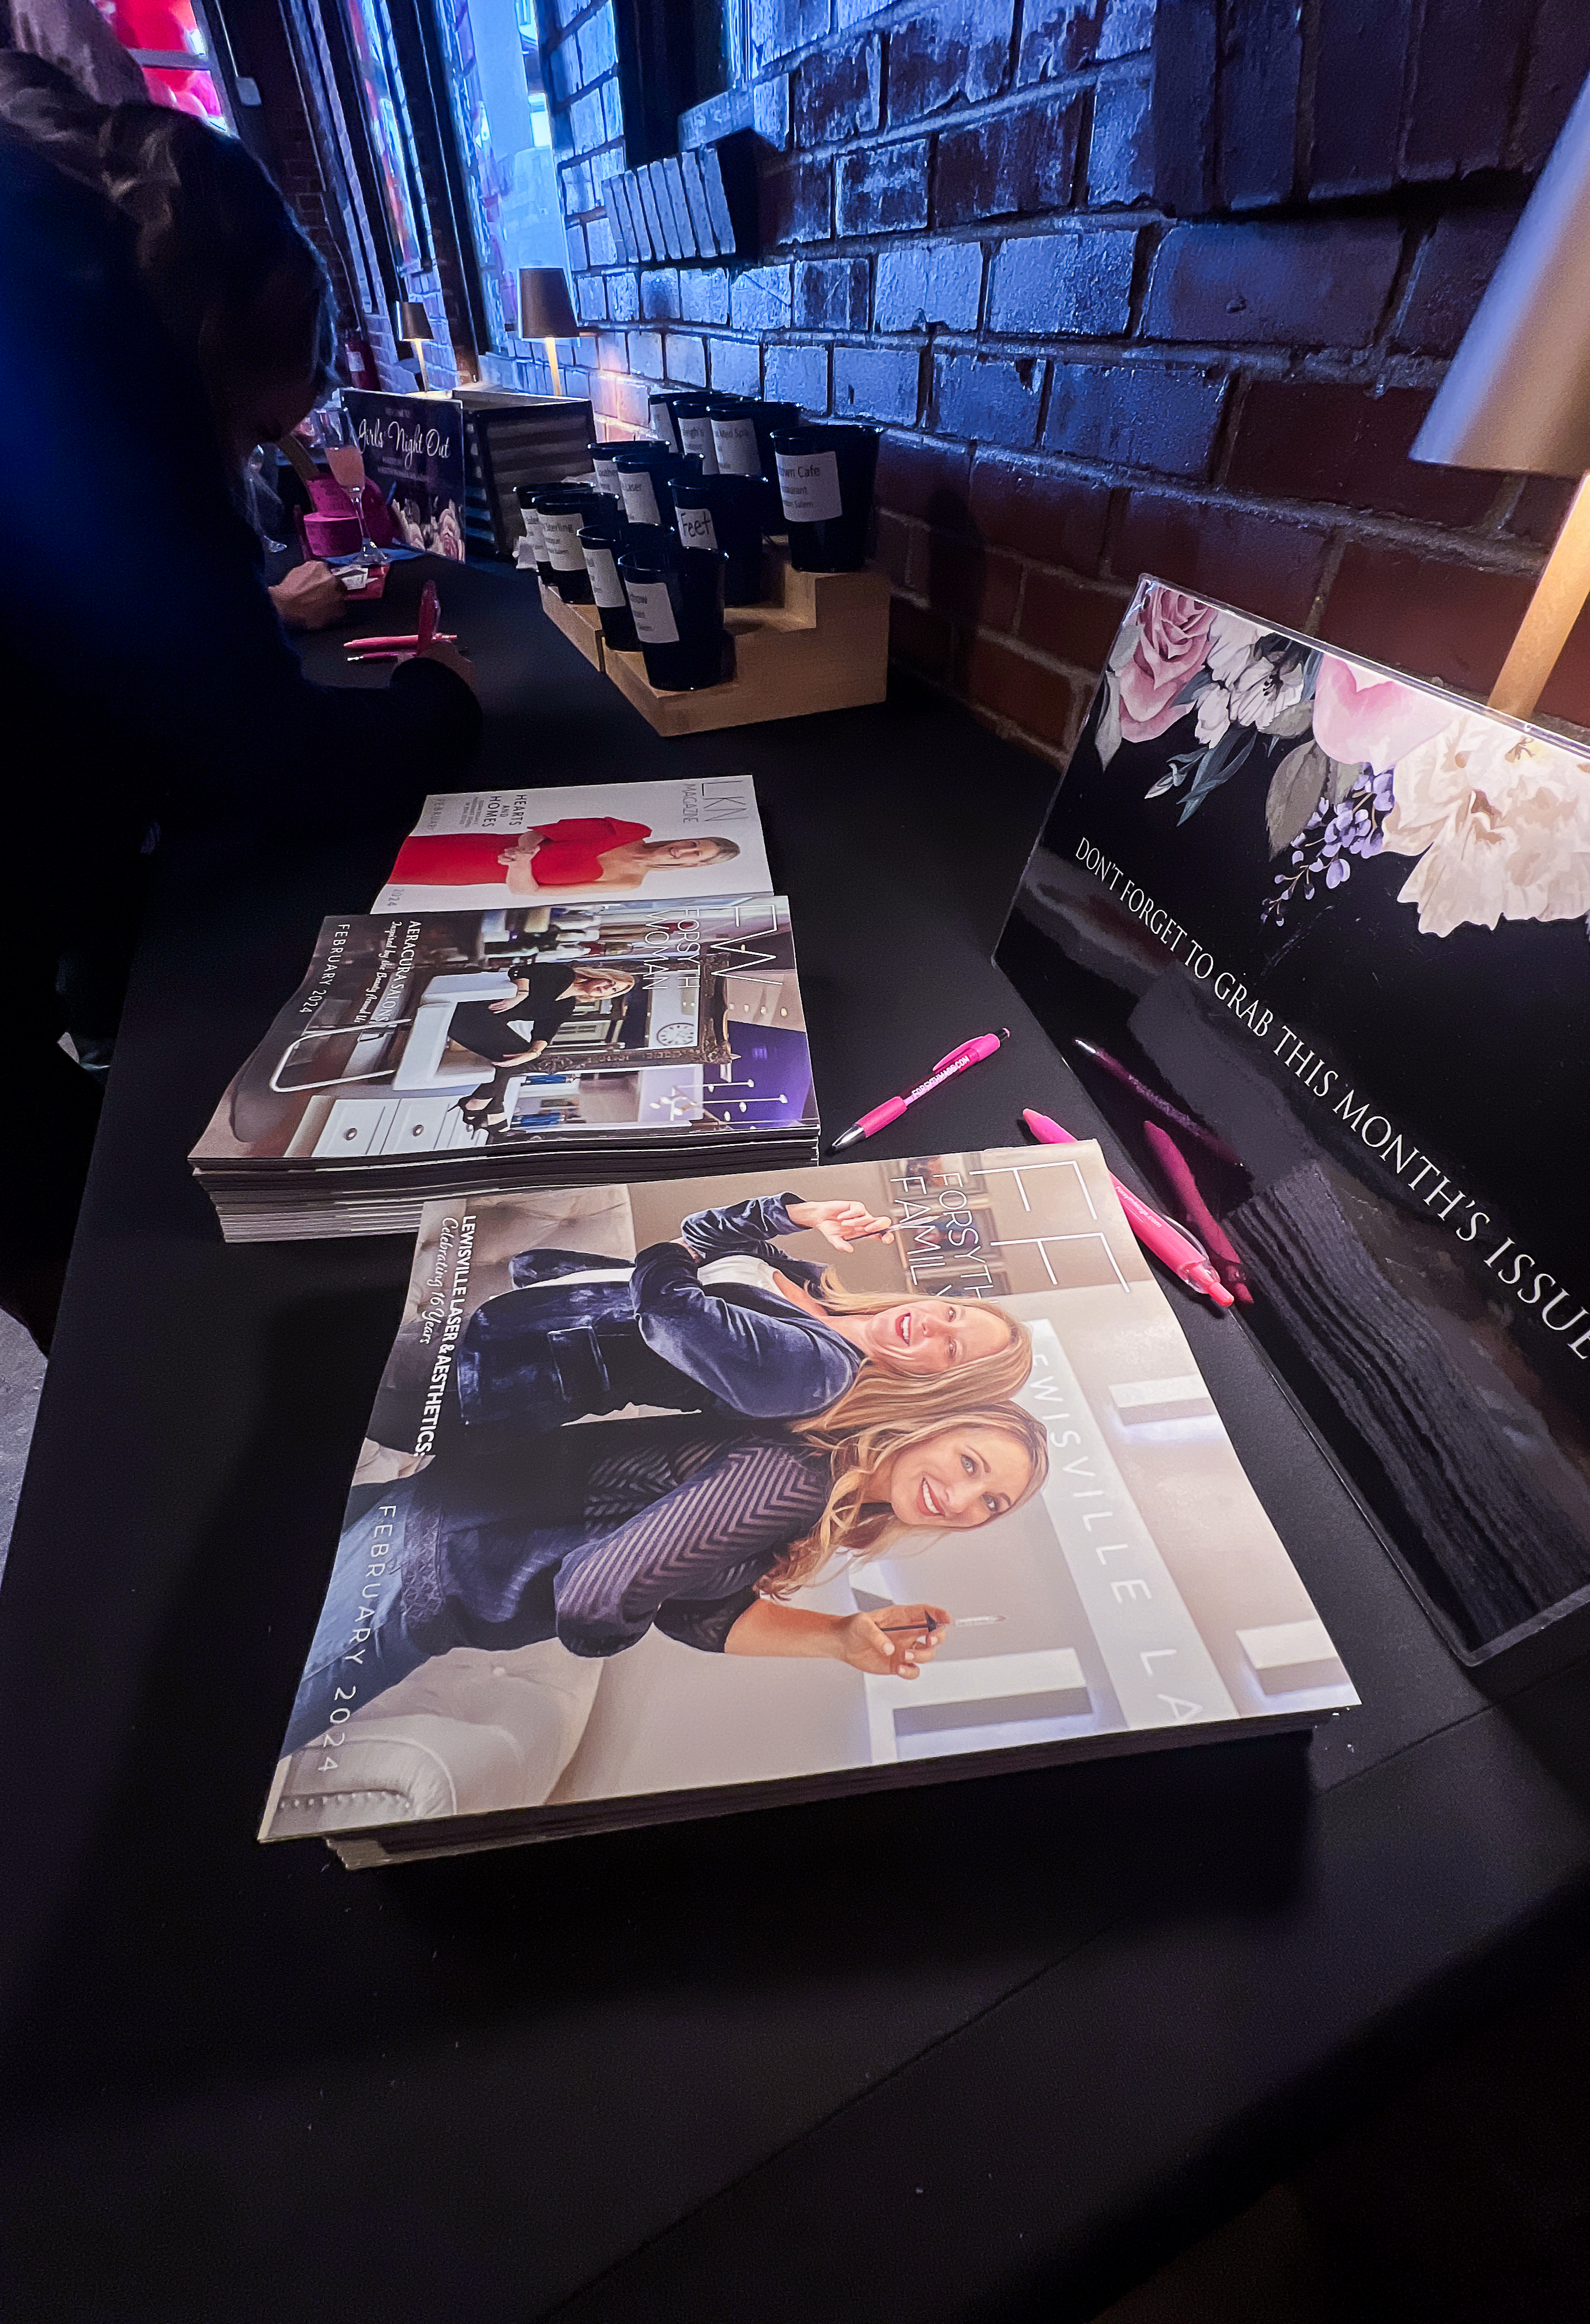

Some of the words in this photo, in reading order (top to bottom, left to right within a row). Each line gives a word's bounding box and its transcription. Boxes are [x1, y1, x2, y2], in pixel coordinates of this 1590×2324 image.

[388, 421, 423, 470] Night
[426, 429, 451, 458] Out
[798, 465, 820, 478] Cafe
[680, 511, 711, 538] Feet
[482, 795, 502, 827] HOMES
[500, 805, 510, 817] AND
[509, 794, 528, 825] HEARTS
[682, 784, 698, 823] MAGAZINE
[702, 780, 749, 821] LKN
[387, 889, 405, 906] 2024
[379, 950, 396, 958] by
[384, 921, 402, 948] Inspired
[392, 920, 421, 982] AERACURA
[642, 910, 670, 990] WOMAN
[677, 908, 701, 989] FORSYTH
[710, 904, 783, 985] FW
[319, 924, 350, 985] FEBRUARY
[379, 960, 392, 970] the
[299, 990, 327, 1013] 2024
[365, 972, 387, 993] Beauty
[359, 994, 377, 1014] Around
[376, 983, 405, 1022] SALONS
[1075, 837, 1124, 891] DON'T
[1120, 880, 1188, 952] FORGET
[1184, 940, 1214, 979] TO
[1215, 972, 1274, 1036] GRAB
[1274, 1025, 1339, 1097] THIS
[1332, 1089, 1490, 1241] MONTH'S
[969, 1160, 1130, 1293] FF
[426, 1217, 459, 1287] Celebrating
[452, 1215, 477, 1296] LEWISVILLE
[430, 1292, 445, 1306] 16
[420, 1308, 445, 1345] Years
[442, 1299, 465, 1342] LASER
[439, 1344, 455, 1353] &
[345, 1505, 396, 1665] FEBRUARY
[318, 1685, 356, 1772] 2024
